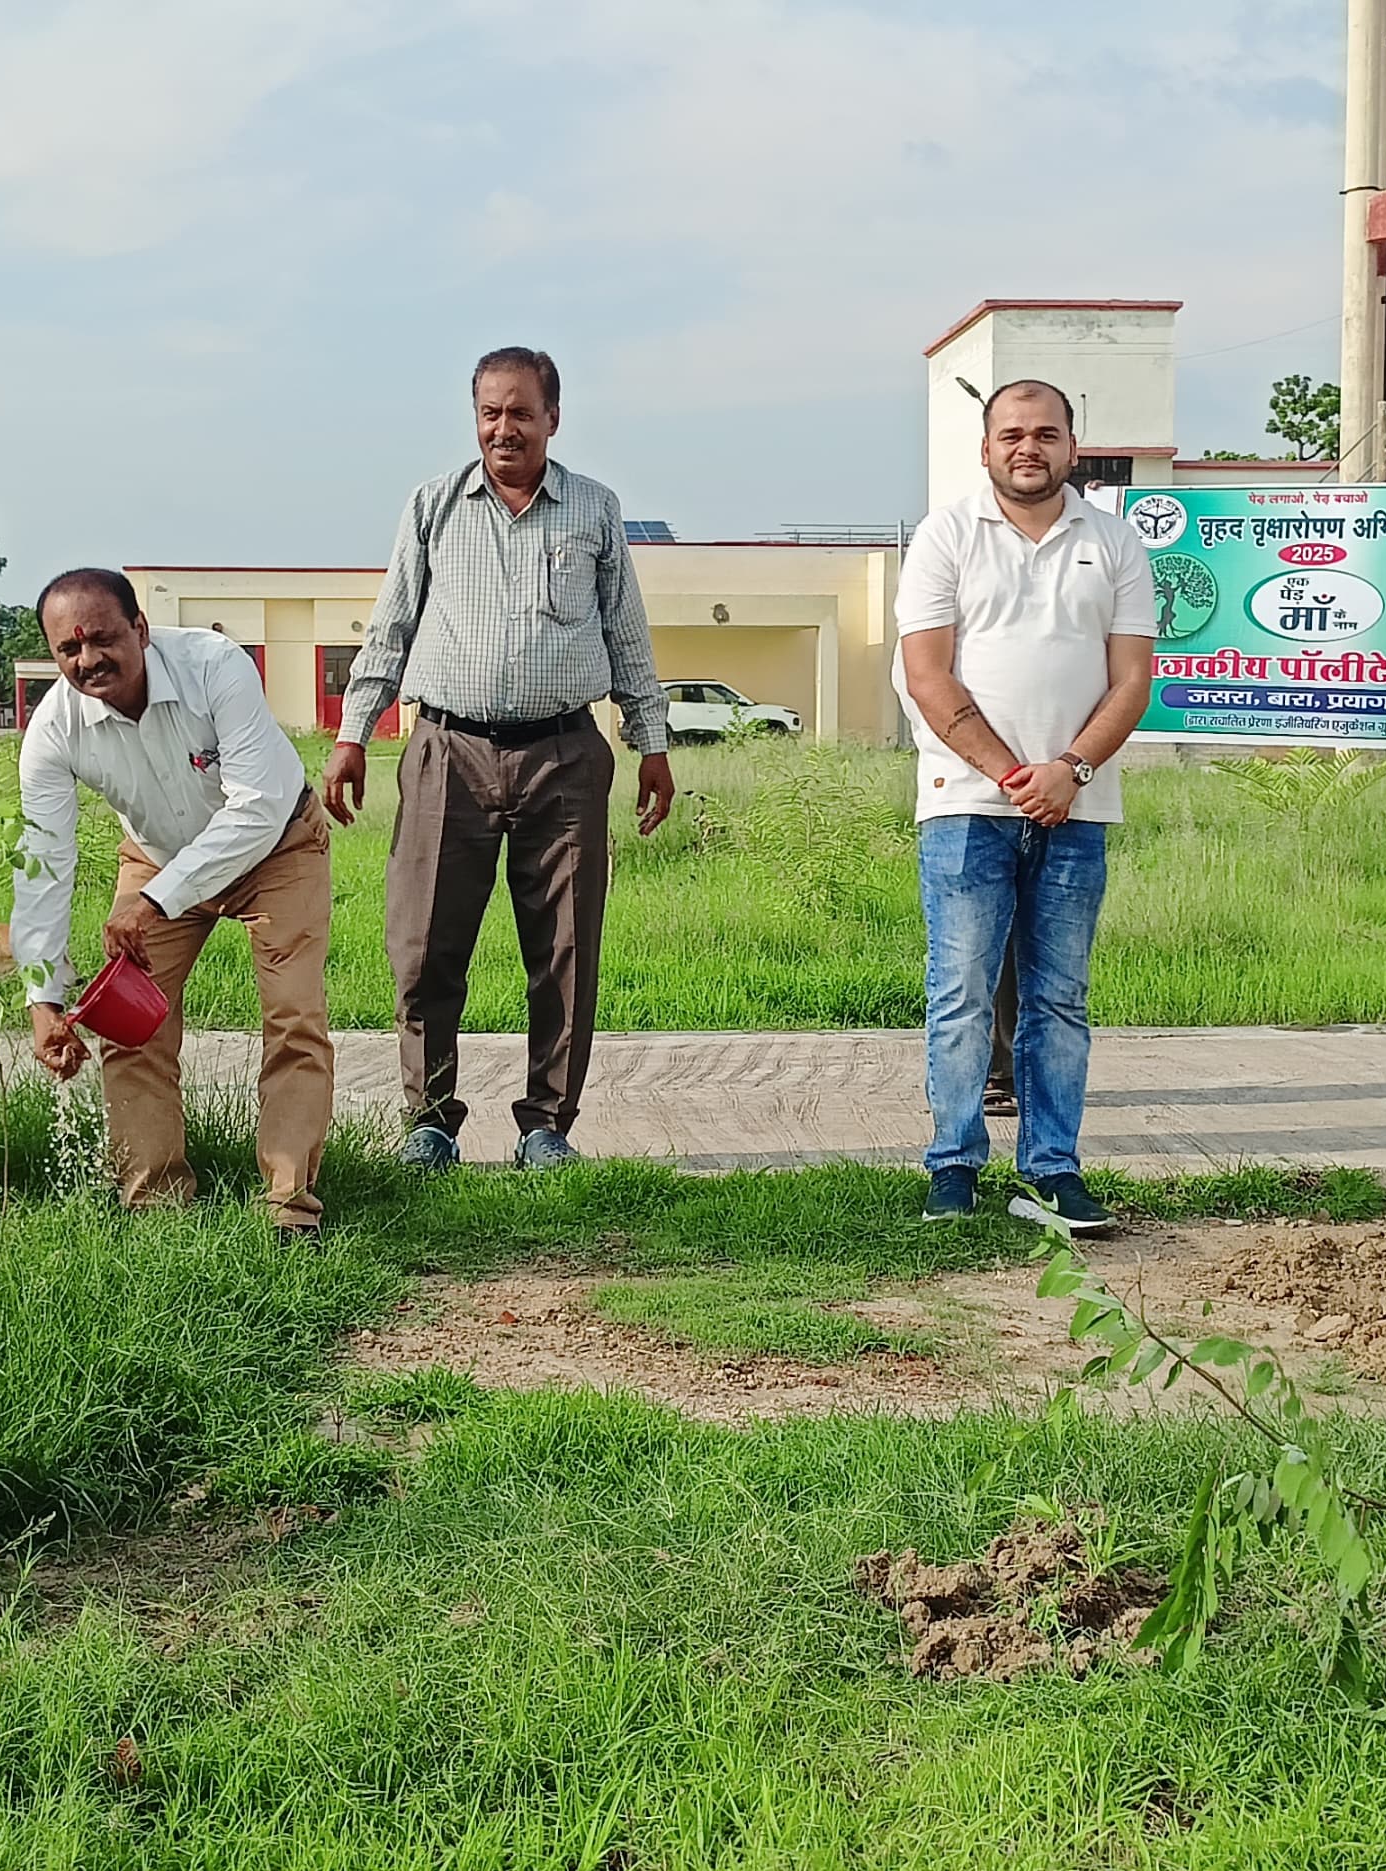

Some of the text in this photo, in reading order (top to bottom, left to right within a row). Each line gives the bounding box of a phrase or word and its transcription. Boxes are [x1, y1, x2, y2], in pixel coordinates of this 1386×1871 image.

[1333, 490, 1369, 504] बचाओ
[1199, 517, 1245, 546] वृहद
[1250, 510, 1346, 546] वृक्षारोपण
[1291, 546, 1334, 561] 2025
[1286, 577, 1310, 588] एक
[1280, 585, 1305, 605] पेड़
[1278, 594, 1337, 631] माँ
[1332, 609, 1347, 619] के
[1332, 621, 1358, 630] नाम
[1151, 649, 1272, 680] ाजकीय
[1187, 689, 1260, 706] जसरा,
[1267, 692, 1321, 709] बारा,
